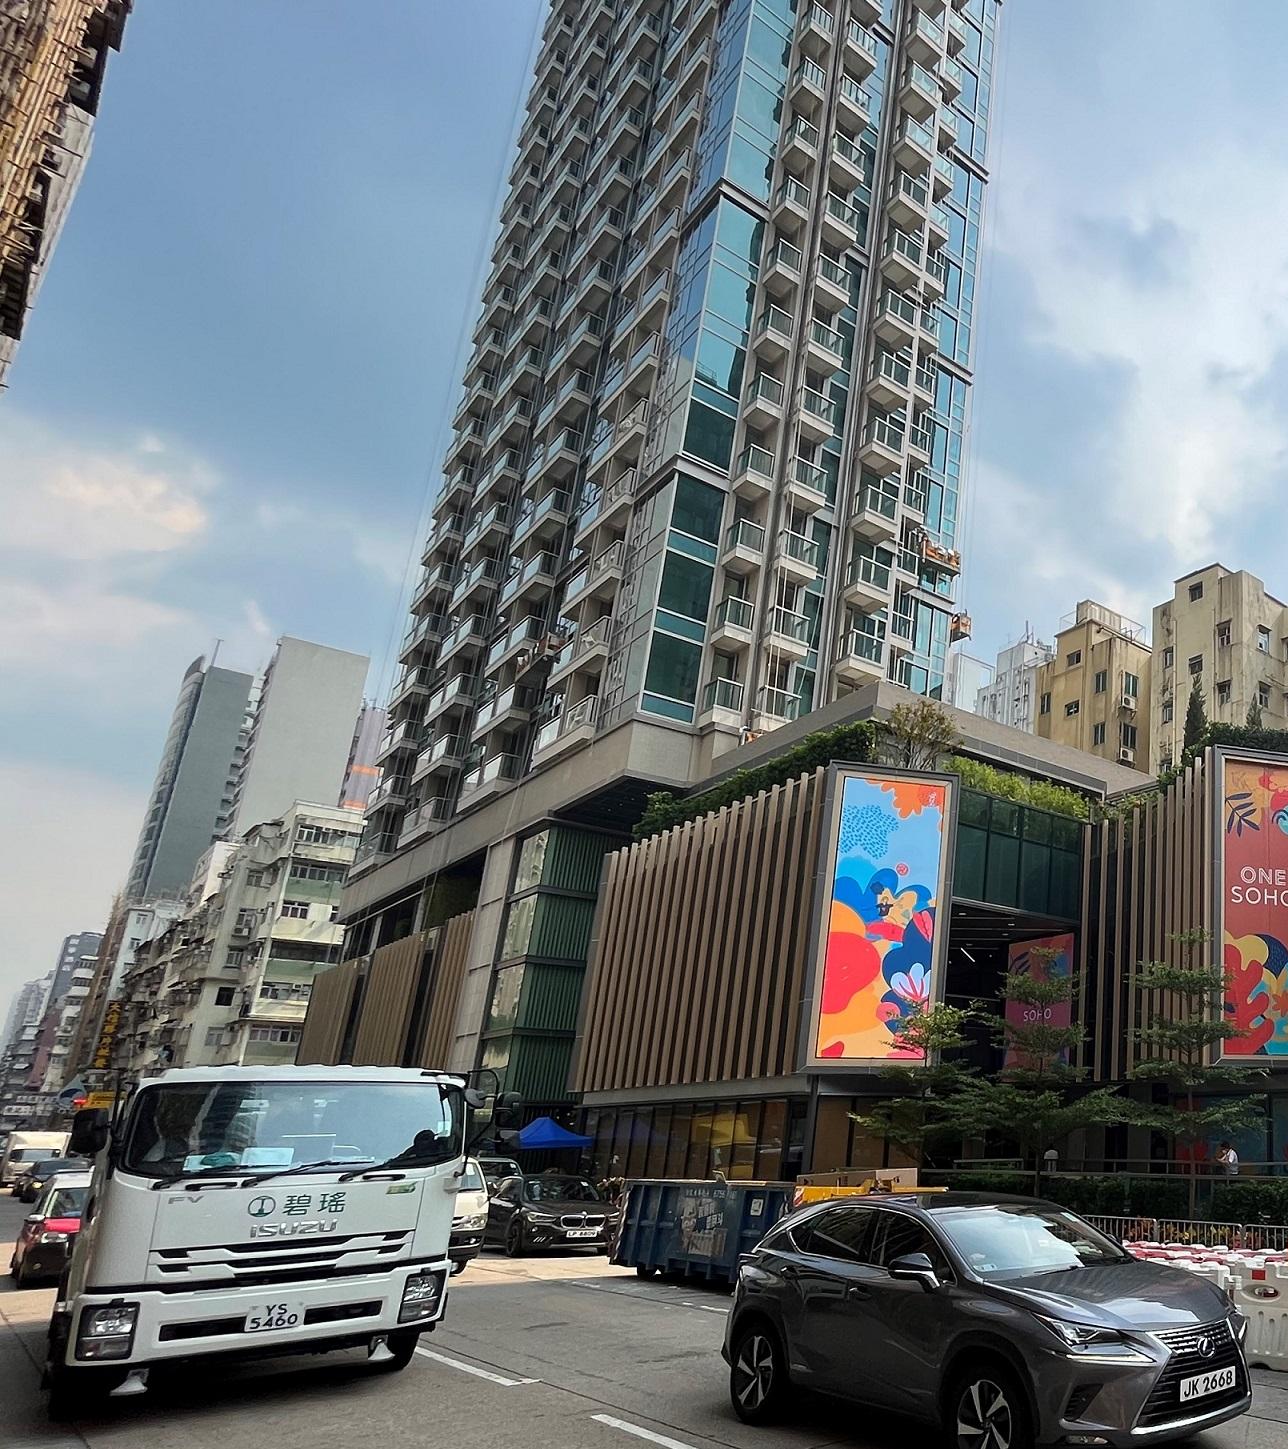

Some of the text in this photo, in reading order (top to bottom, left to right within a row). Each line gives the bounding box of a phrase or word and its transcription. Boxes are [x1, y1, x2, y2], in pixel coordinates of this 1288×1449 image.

[1240, 866, 1287, 886] ONE
[1023, 1008, 1052, 1021] SOHO
[282, 1191, 347, 1217] 碧瑤
[250, 1218, 338, 1239] ISUZU
[265, 1303, 288, 1316] YS
[249, 1313, 299, 1330] 5460
[1183, 1370, 1233, 1398] JK 2668
